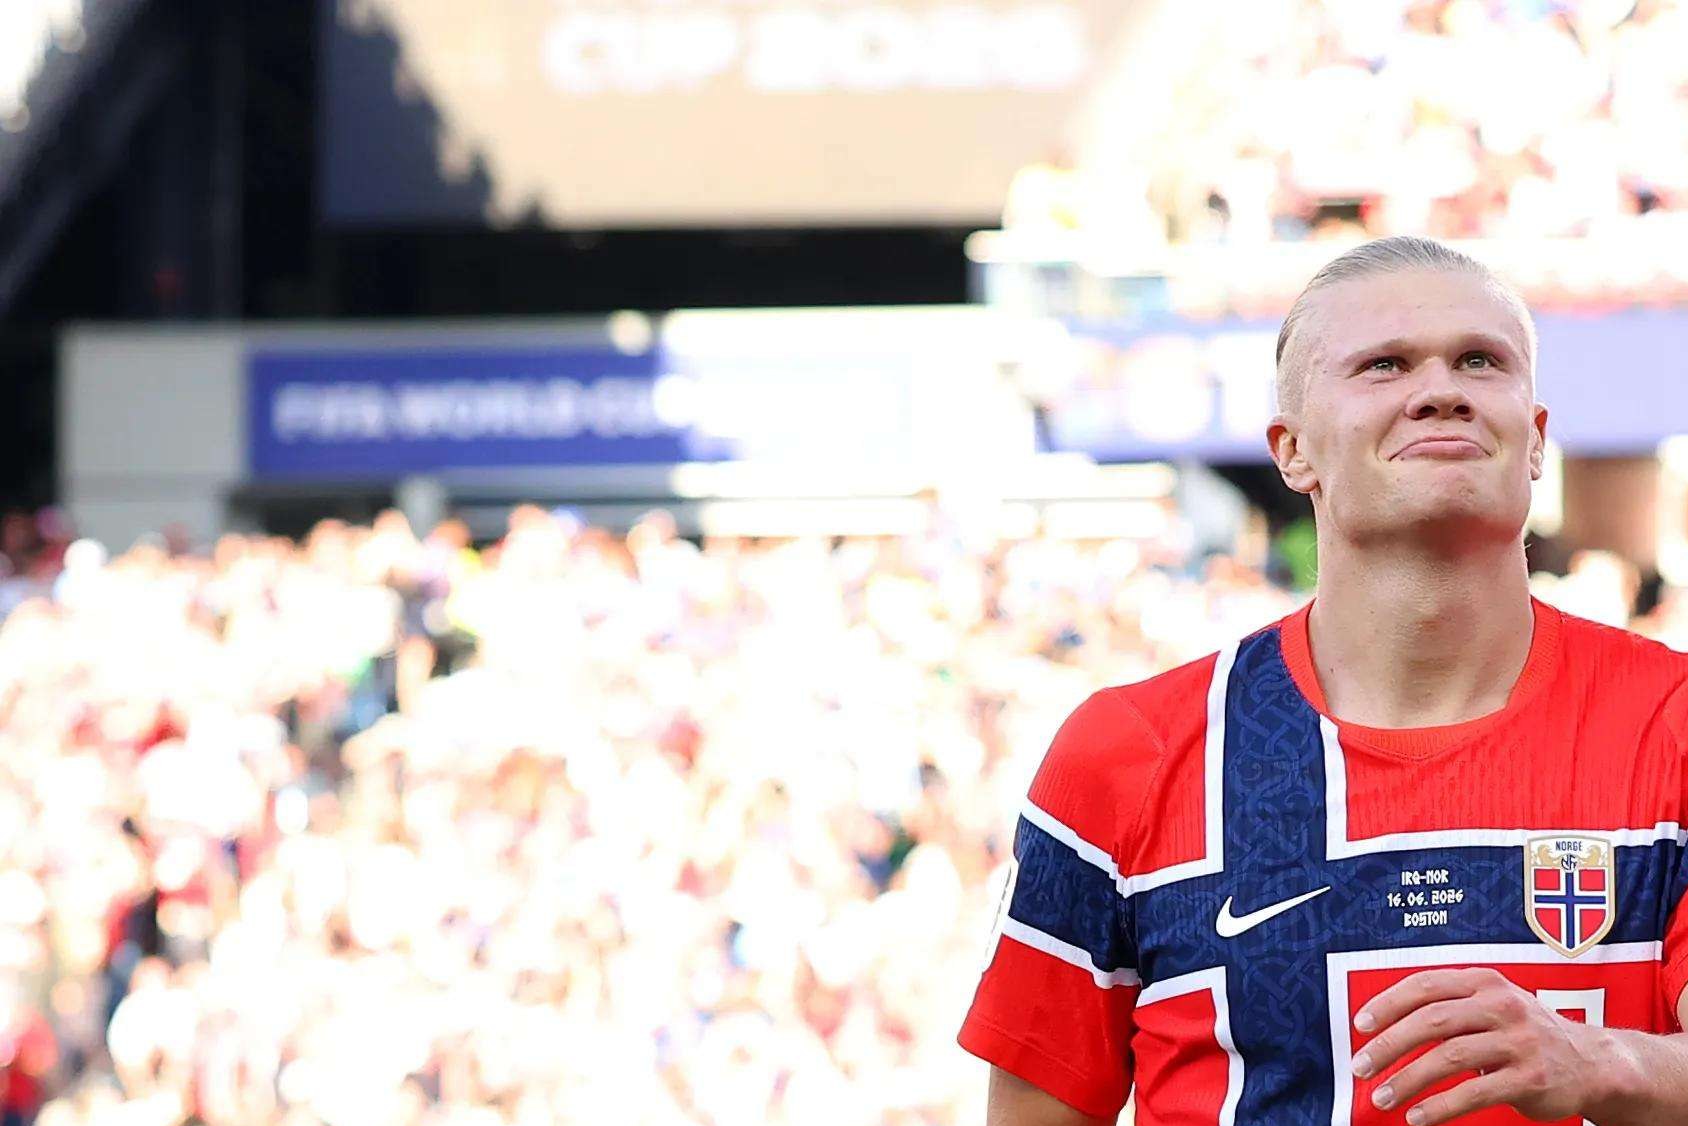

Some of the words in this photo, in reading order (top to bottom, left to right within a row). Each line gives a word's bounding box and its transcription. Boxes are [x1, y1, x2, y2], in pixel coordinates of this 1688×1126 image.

[1555, 840, 1583, 851] NORGE
[1402, 869, 1449, 886] IRQ-NOR
[1404, 910, 1448, 927] BOSTON
